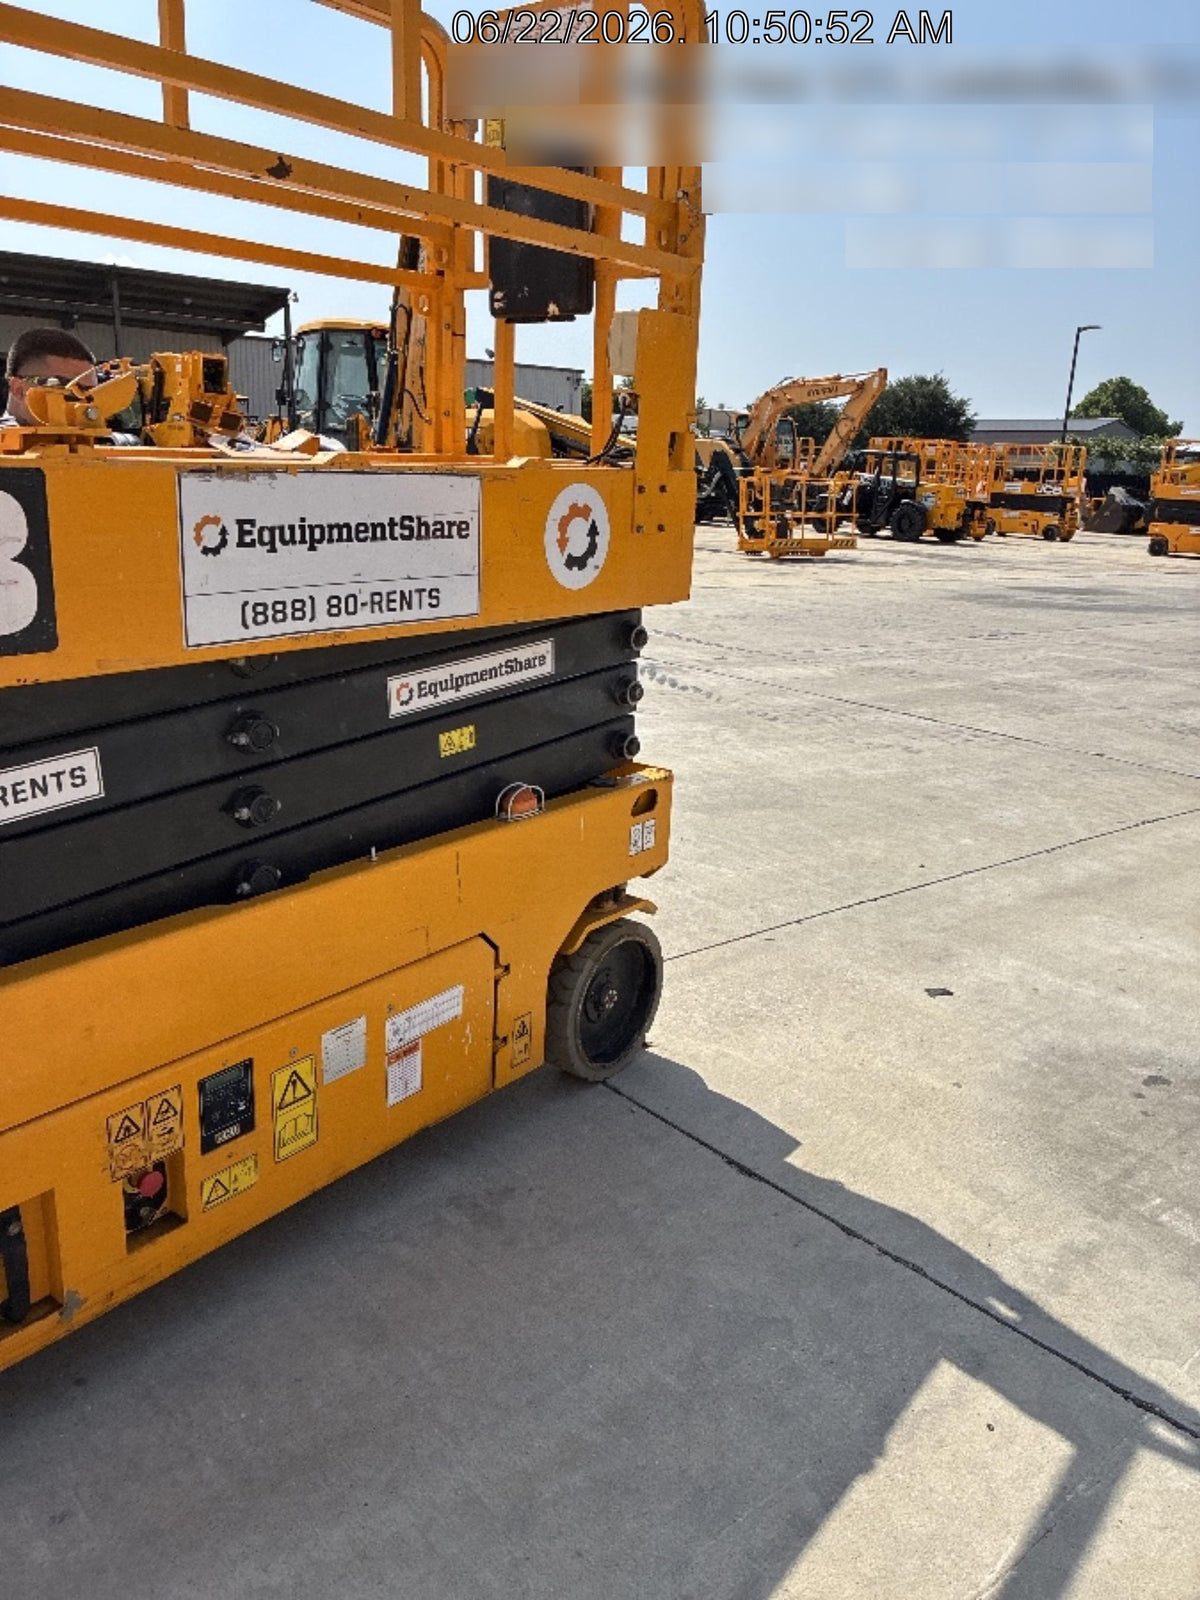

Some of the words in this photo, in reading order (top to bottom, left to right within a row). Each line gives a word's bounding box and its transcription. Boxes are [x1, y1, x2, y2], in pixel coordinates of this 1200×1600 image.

[234, 514, 470, 553] EquipmentShare
[240, 595, 315, 630] (888)
[326, 587, 441, 618] 80-RENTS
[417, 653, 547, 699] EquipmentShare
